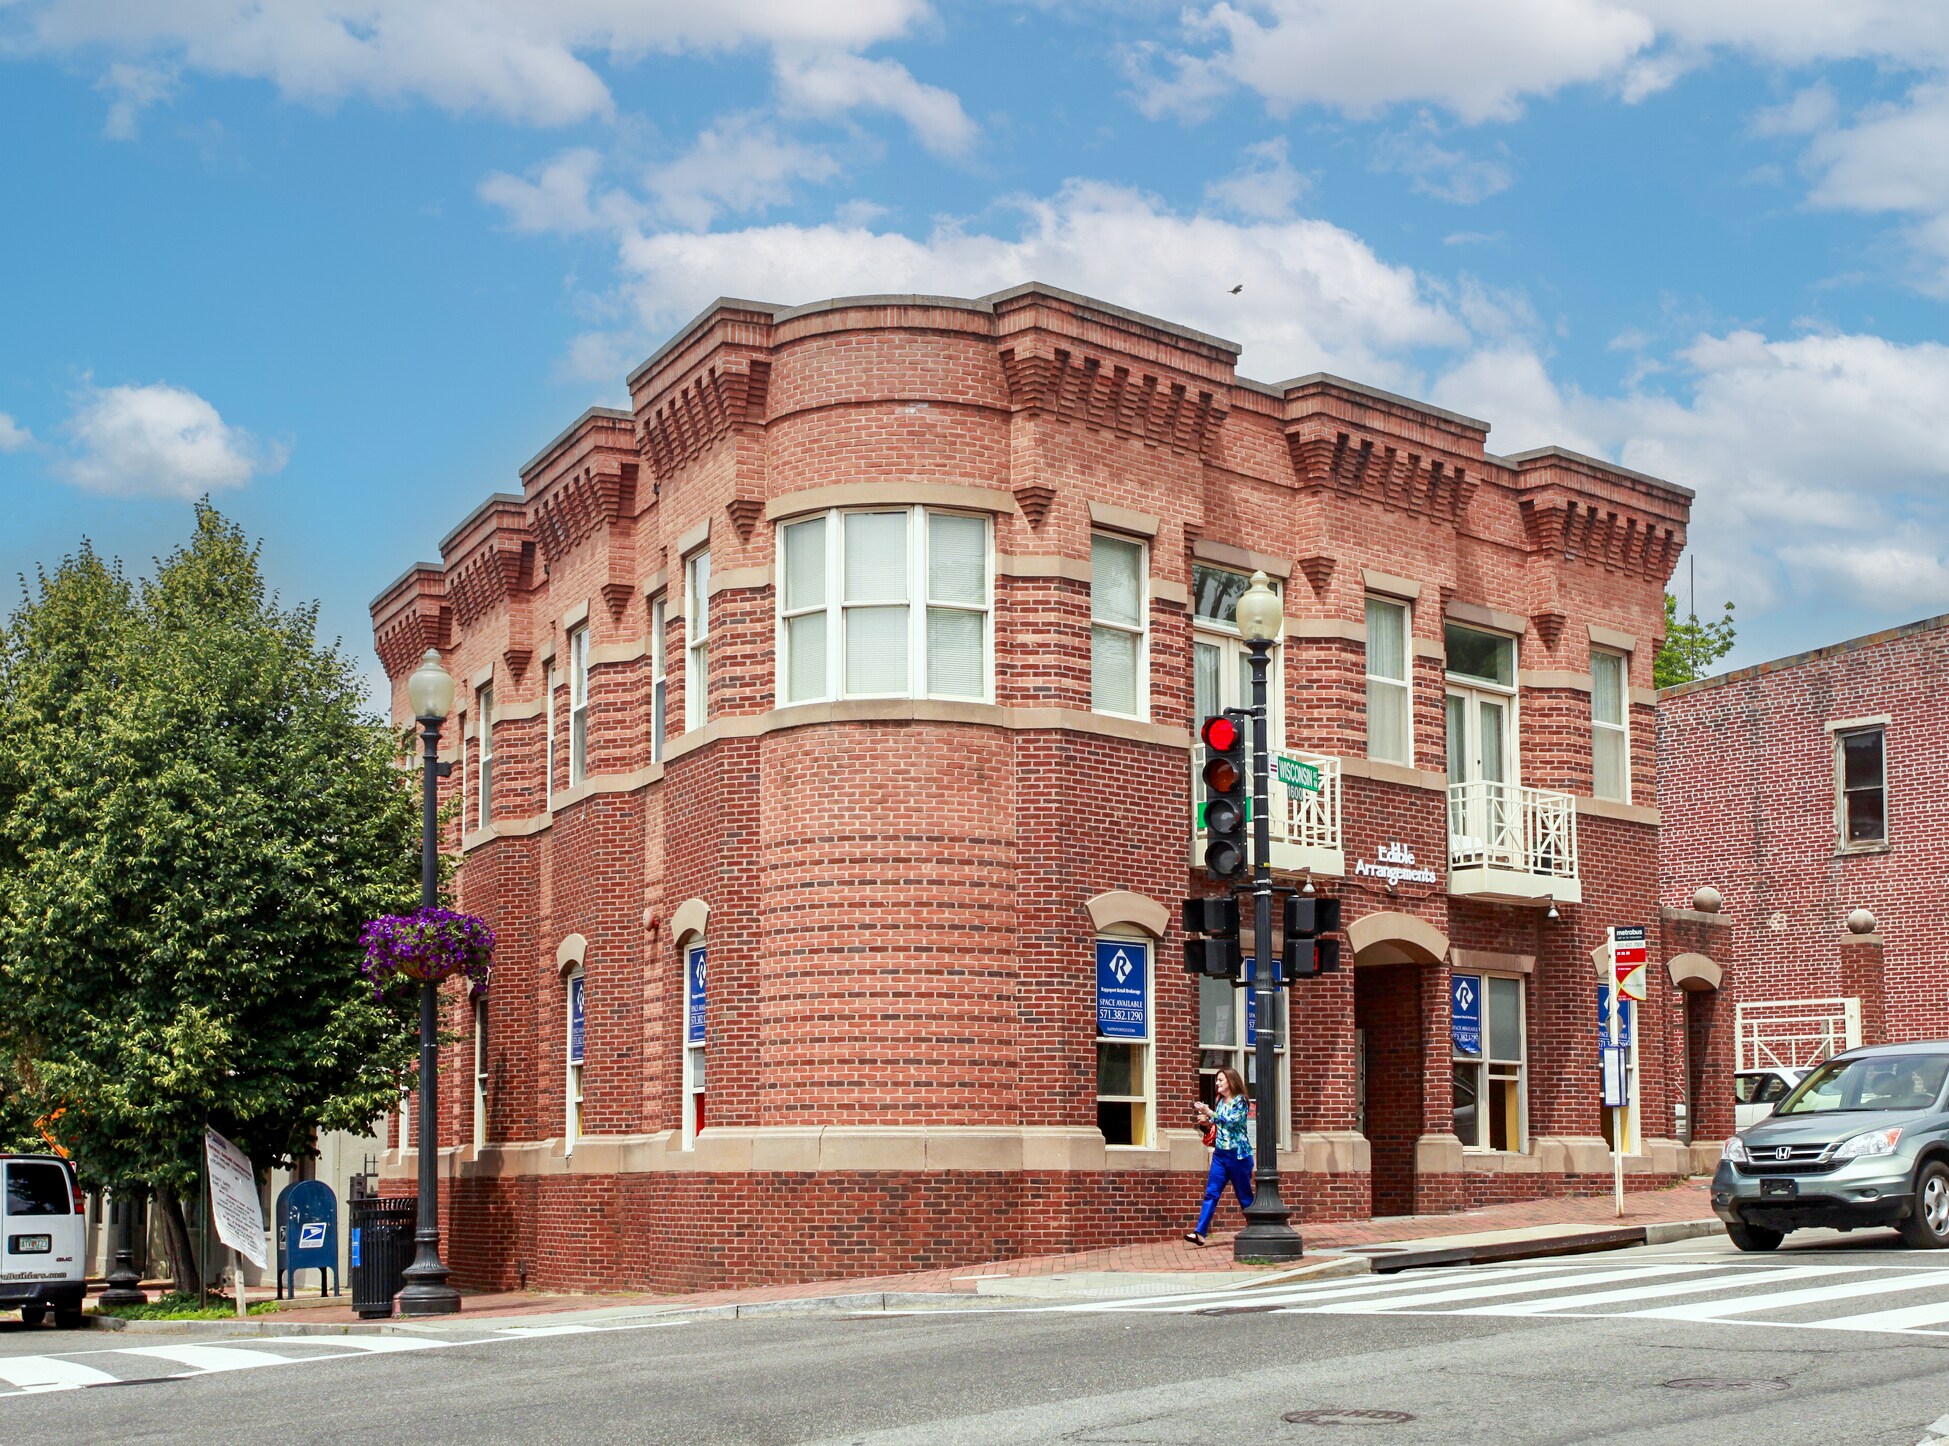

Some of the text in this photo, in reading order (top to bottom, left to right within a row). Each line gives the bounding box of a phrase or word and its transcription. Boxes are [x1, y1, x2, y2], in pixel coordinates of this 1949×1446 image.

[1279, 759, 1313, 788] WISCONSIN
[1288, 785, 1303, 801] 1600
[1378, 842, 1416, 865] Edible
[1355, 859, 1437, 886] Arrangements
[1116, 1000, 1143, 1008] AVAILABLE
[1099, 1009, 1143, 1022] 571.382.1290
